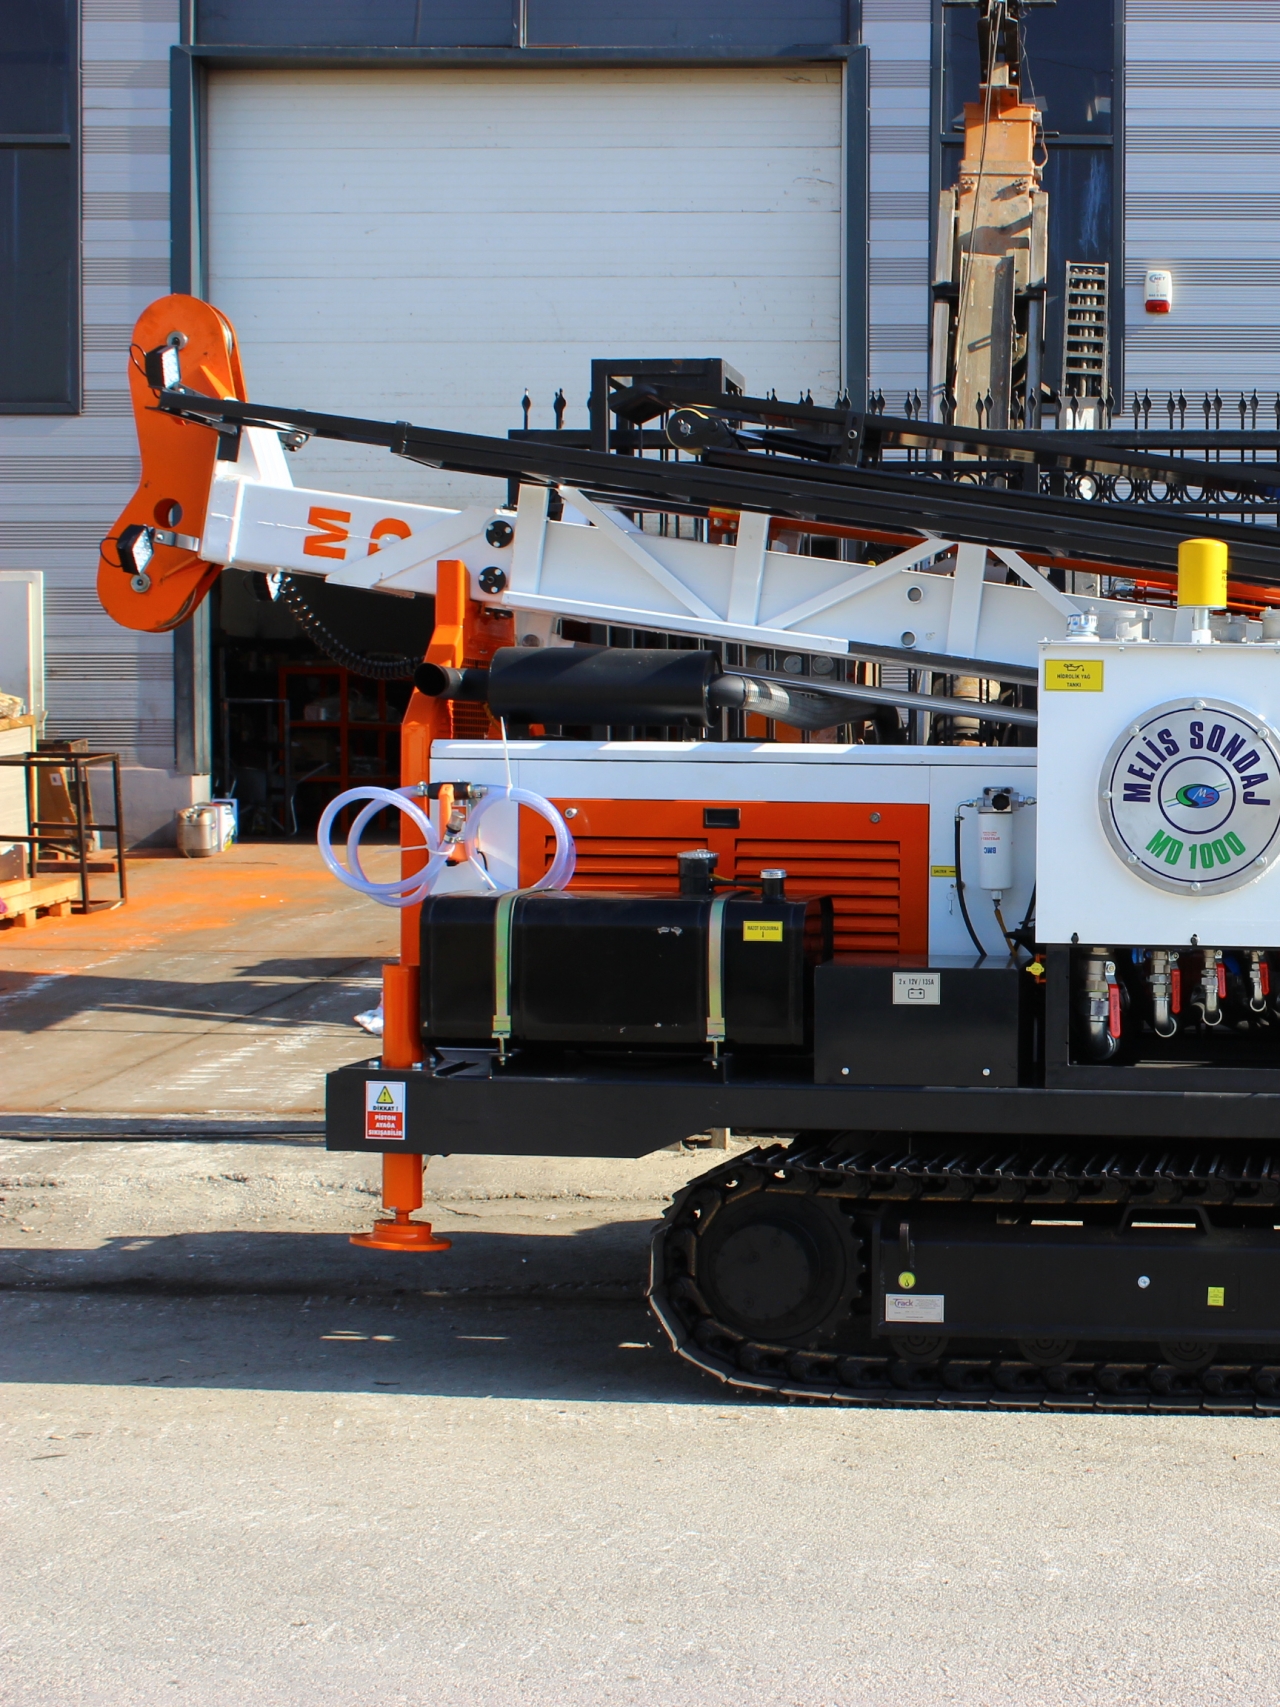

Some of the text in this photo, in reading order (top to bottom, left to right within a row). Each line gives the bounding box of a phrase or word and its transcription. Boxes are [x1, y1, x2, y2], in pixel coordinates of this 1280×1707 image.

[1123, 721, 1271, 806] MELİS SONDAJ
[1145, 829, 1246, 869] MD 1000
